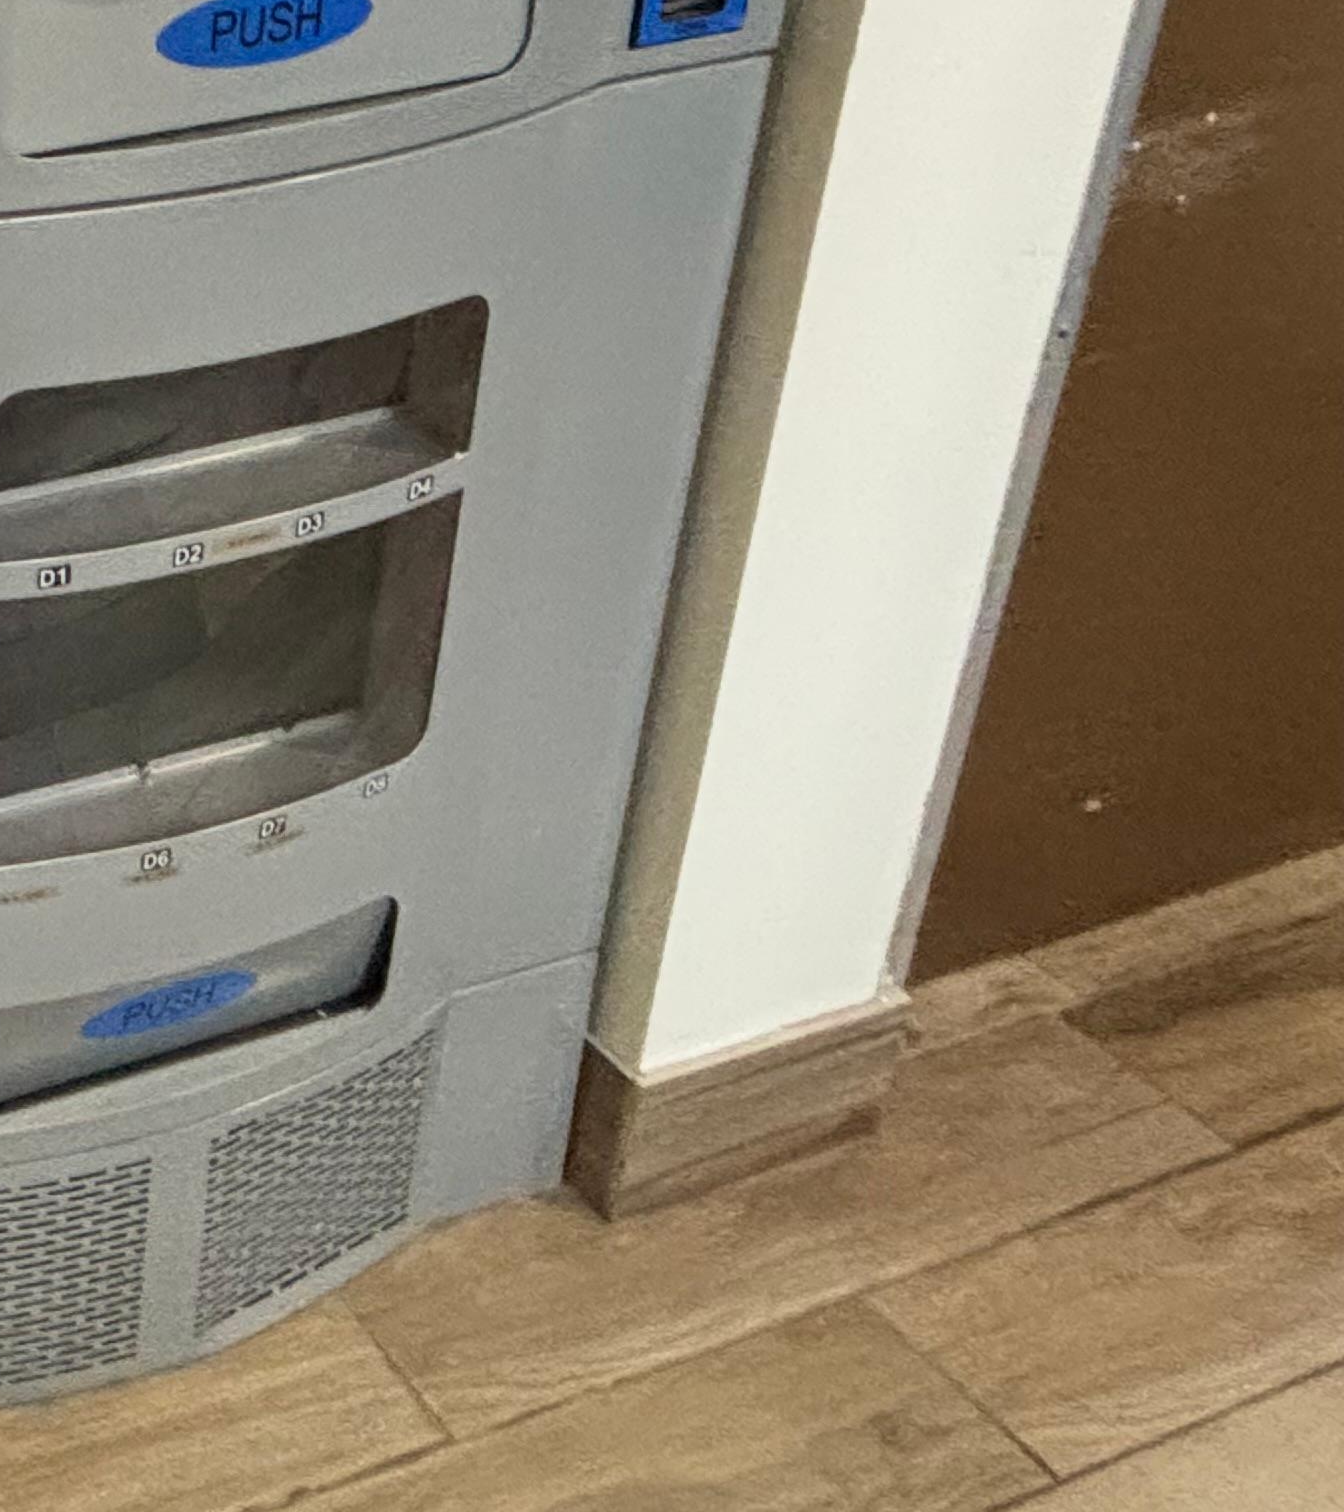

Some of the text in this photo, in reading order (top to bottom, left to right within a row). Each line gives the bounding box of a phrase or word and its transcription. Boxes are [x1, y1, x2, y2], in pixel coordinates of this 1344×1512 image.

[39, 477, 431, 588] D1 D2 D3 D4
[142, 850, 170, 871] D6
[261, 817, 286, 838] D7
[122, 984, 215, 1027] PUSH
